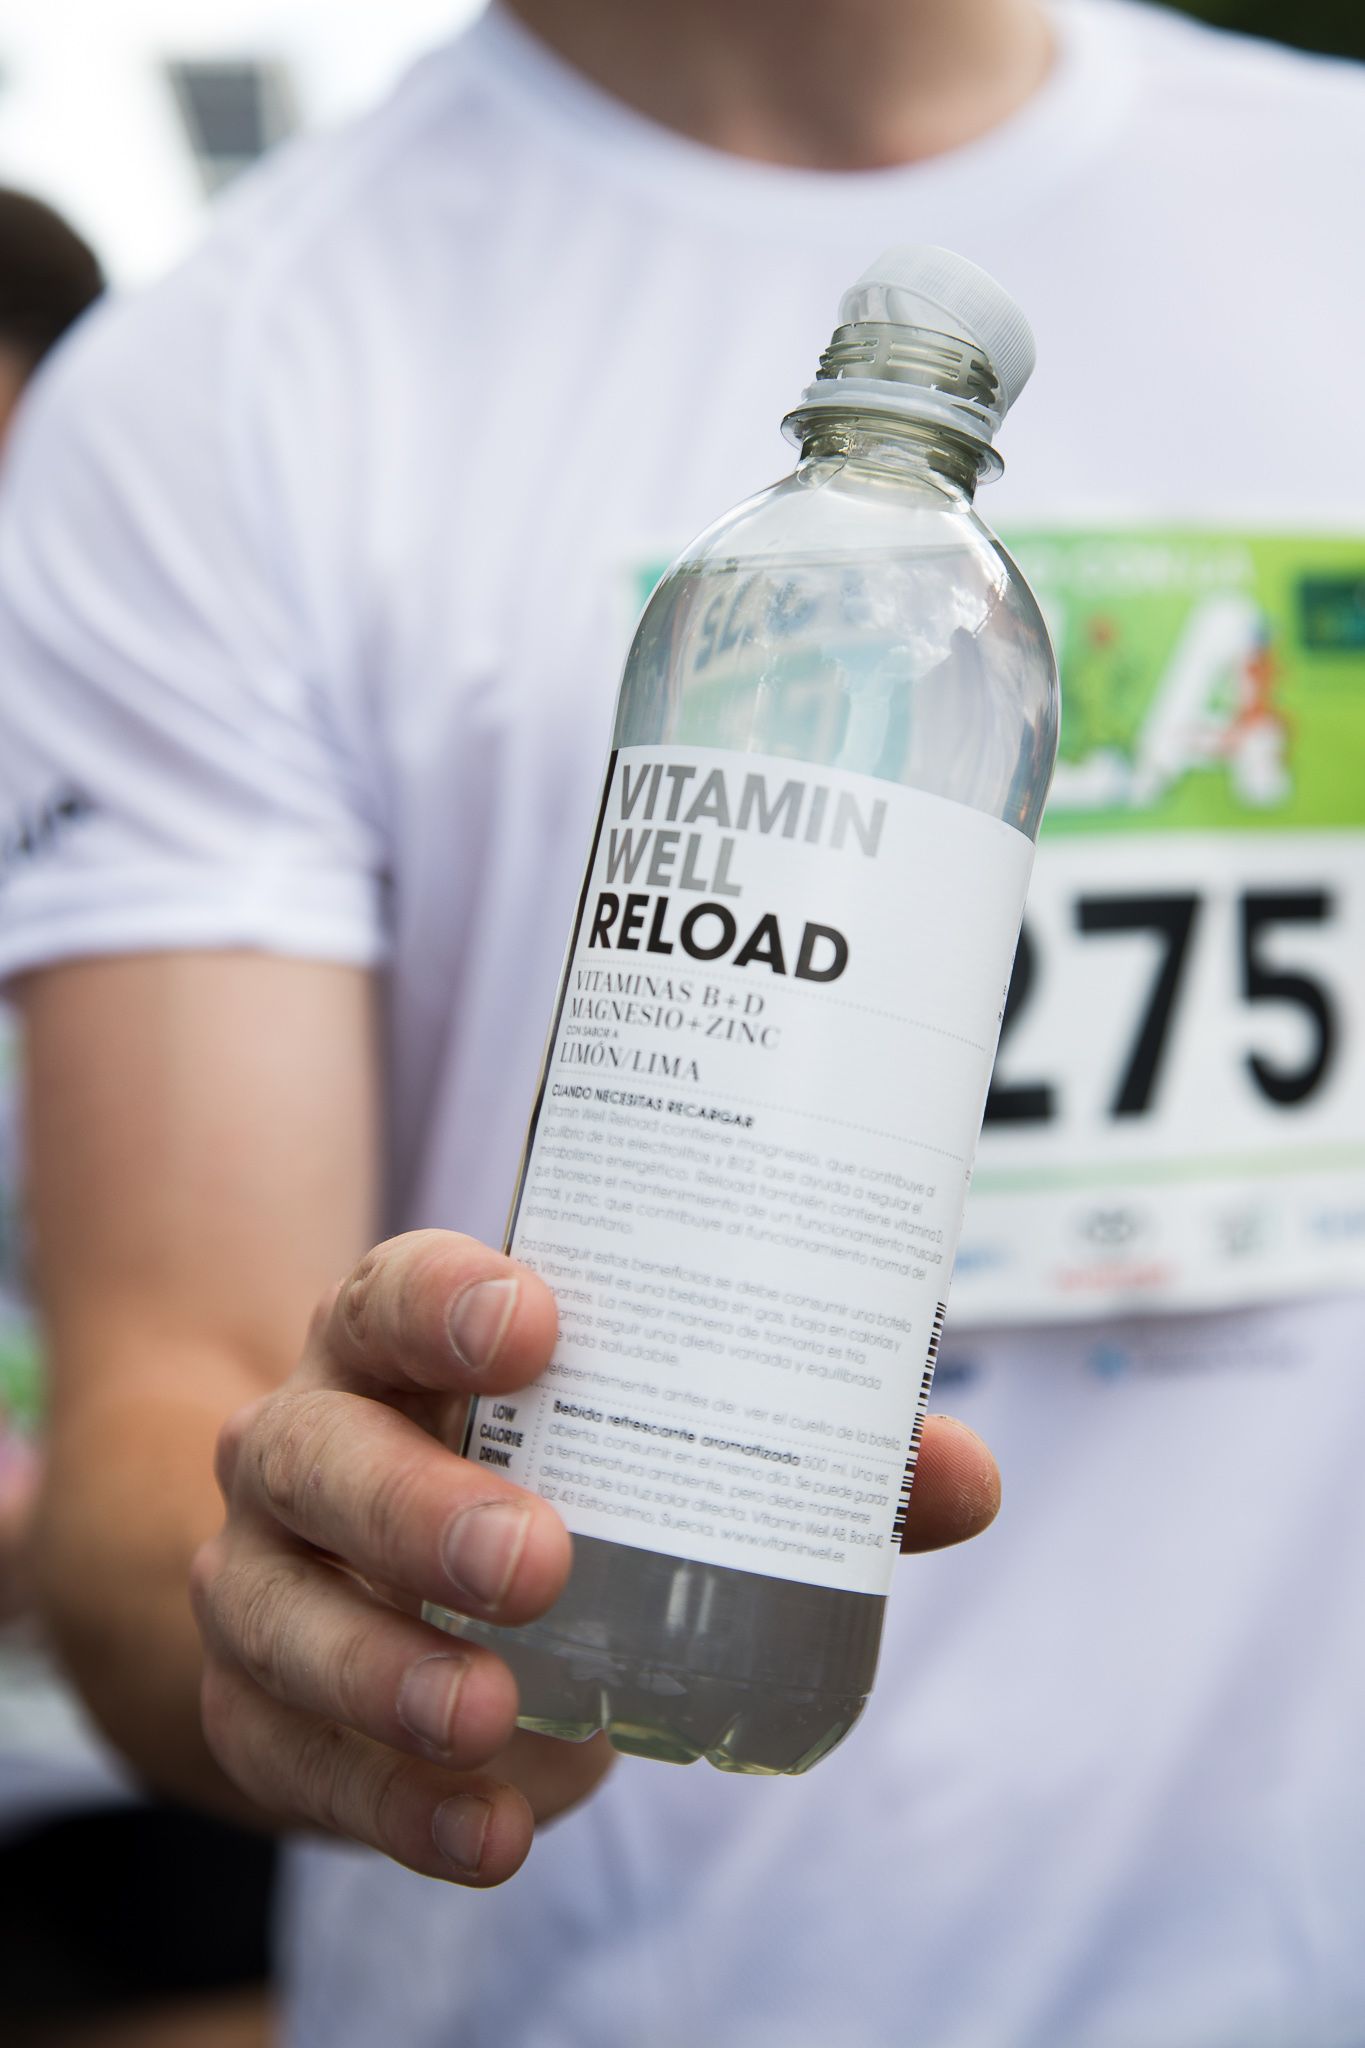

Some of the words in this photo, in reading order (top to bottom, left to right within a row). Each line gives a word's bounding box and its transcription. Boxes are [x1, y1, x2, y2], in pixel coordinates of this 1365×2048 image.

[620, 763, 889, 860] VITAMIN
[605, 827, 743, 898] WELL
[587, 891, 850, 984] RELOAD
[573, 967, 693, 1004] VITAMINAS
[701, 984, 766, 1018] B+D
[568, 995, 781, 1051] MAGNESIO+ZINC
[559, 1039, 702, 1083] LIMÓN/LIMA
[552, 1083, 591, 1100] CUANDO
[593, 1088, 663, 1111] NECESITAS
[666, 1100, 755, 1129] RECARGAR
[478, 1423, 524, 1448] CALORIE
[491, 1403, 518, 1423] LOW
[552, 1400, 603, 1423] Bebida
[606, 1416, 696, 1444] refrescante
[478, 1446, 512, 1468] DRINK
